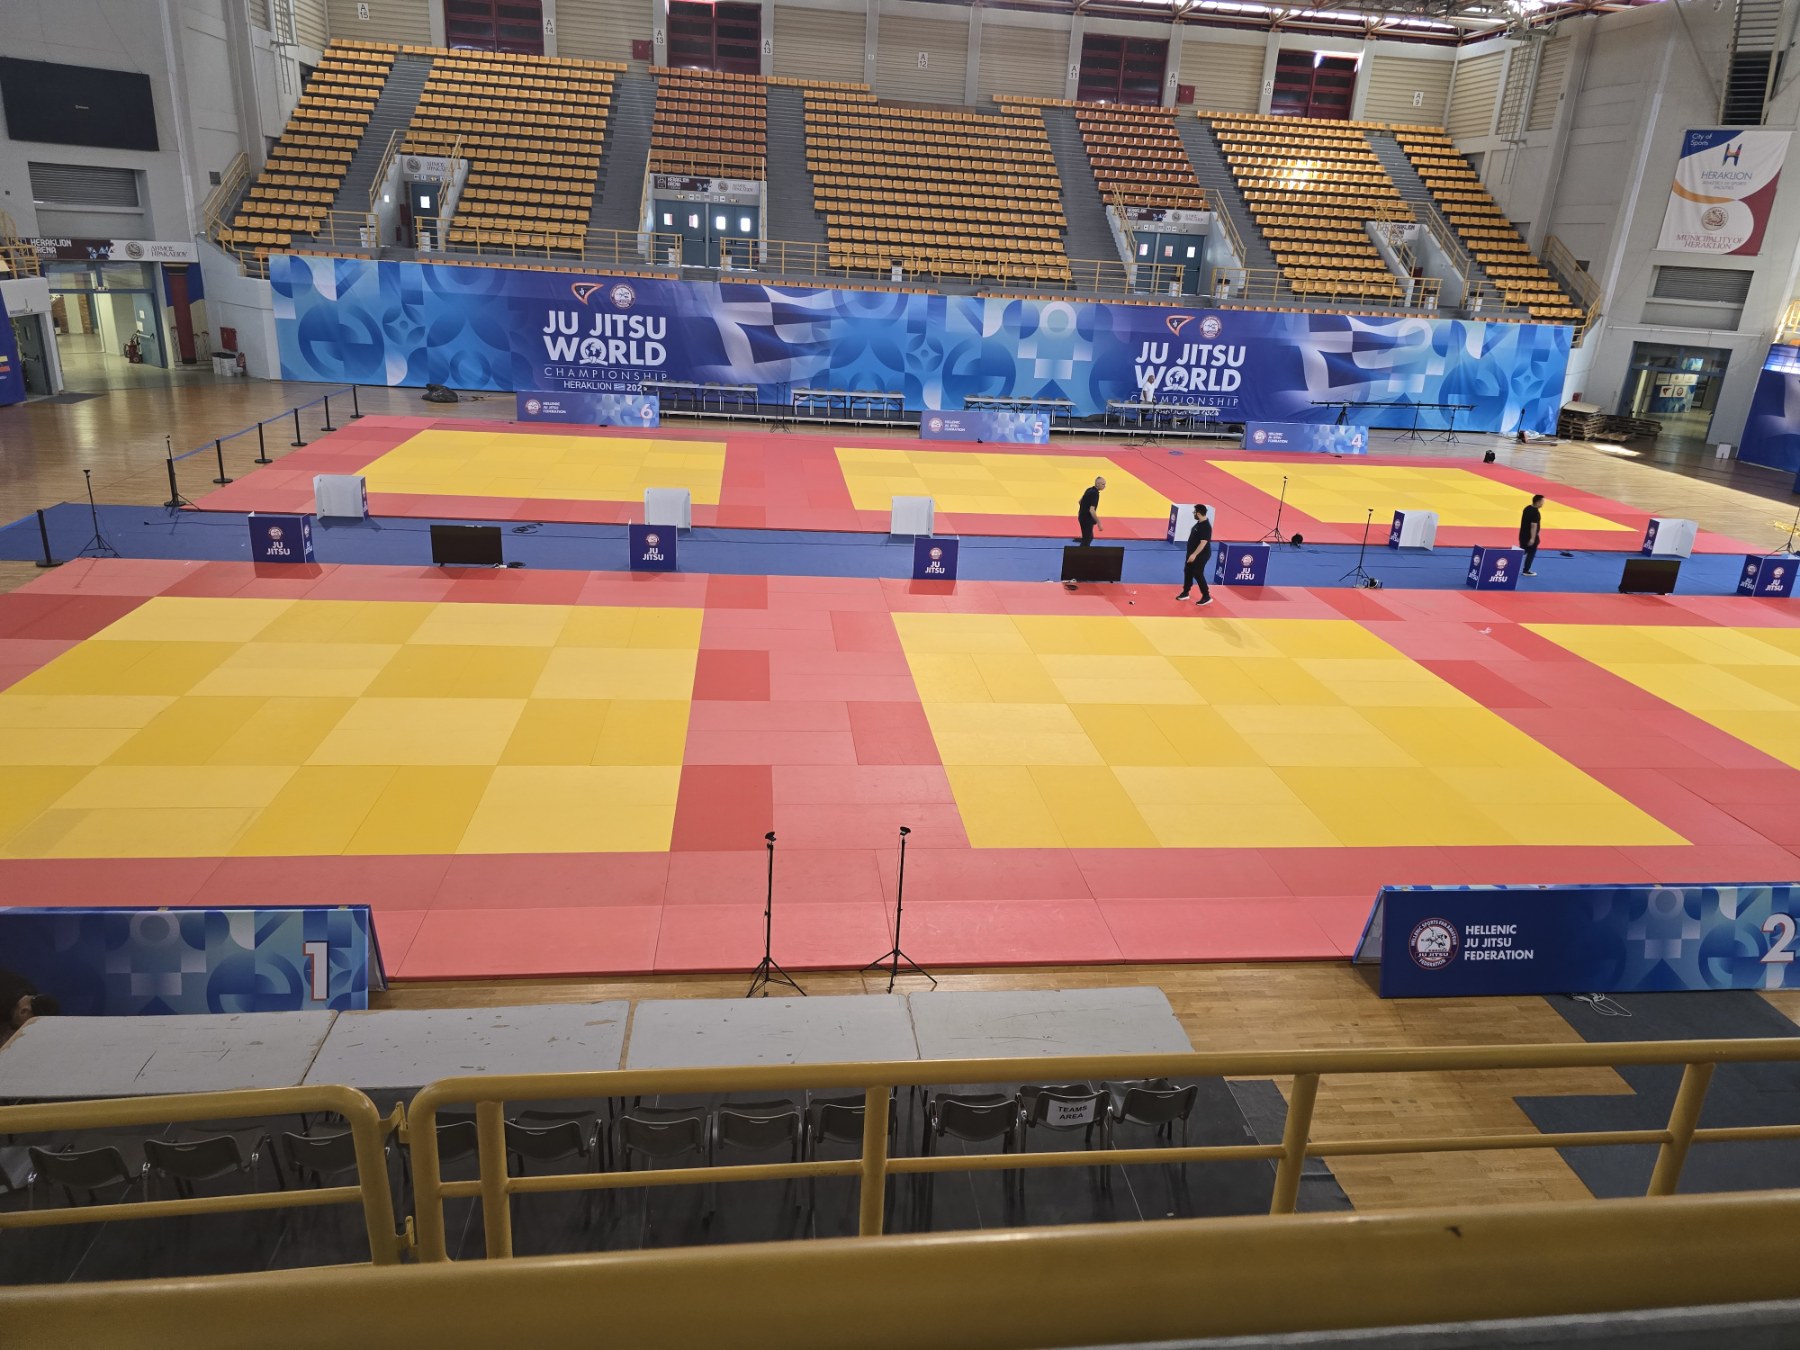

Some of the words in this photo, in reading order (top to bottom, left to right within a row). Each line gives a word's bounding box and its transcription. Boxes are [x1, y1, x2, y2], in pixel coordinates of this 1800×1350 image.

[1701, 170, 1752, 180] HERAKLION
[30, 238, 72, 248] HERAKLION
[1676, 234, 1732, 244] MUNICIPALITY
[1684, 240, 1732, 250] HERAKLION
[543, 310, 578, 335] JU
[589, 313, 666, 340] JITSU
[543, 336, 667, 366] WORLD
[1136, 342, 1169, 364] JU
[1176, 344, 1246, 368] JITSU
[544, 366, 668, 380] CHAMPIONSHIP
[1134, 364, 1241, 392] WORLD
[564, 380, 612, 391] HERAKLION
[626, 384, 647, 392] 202
[1130, 394, 1239, 406] CMPIONSHIP
[640, 404, 654, 419] 6
[1032, 421, 1044, 436] 5
[1352, 434, 1362, 448] 4
[1466, 924, 1517, 934] HELLENIC
[1464, 938, 1478, 948] JU
[1481, 938, 1512, 948] JITSU
[1760, 912, 1796, 962] 2
[1464, 950, 1534, 960] FEDERATION
[1418, 958, 1446, 967] FEDERATION
[303, 941, 329, 1000] 1
